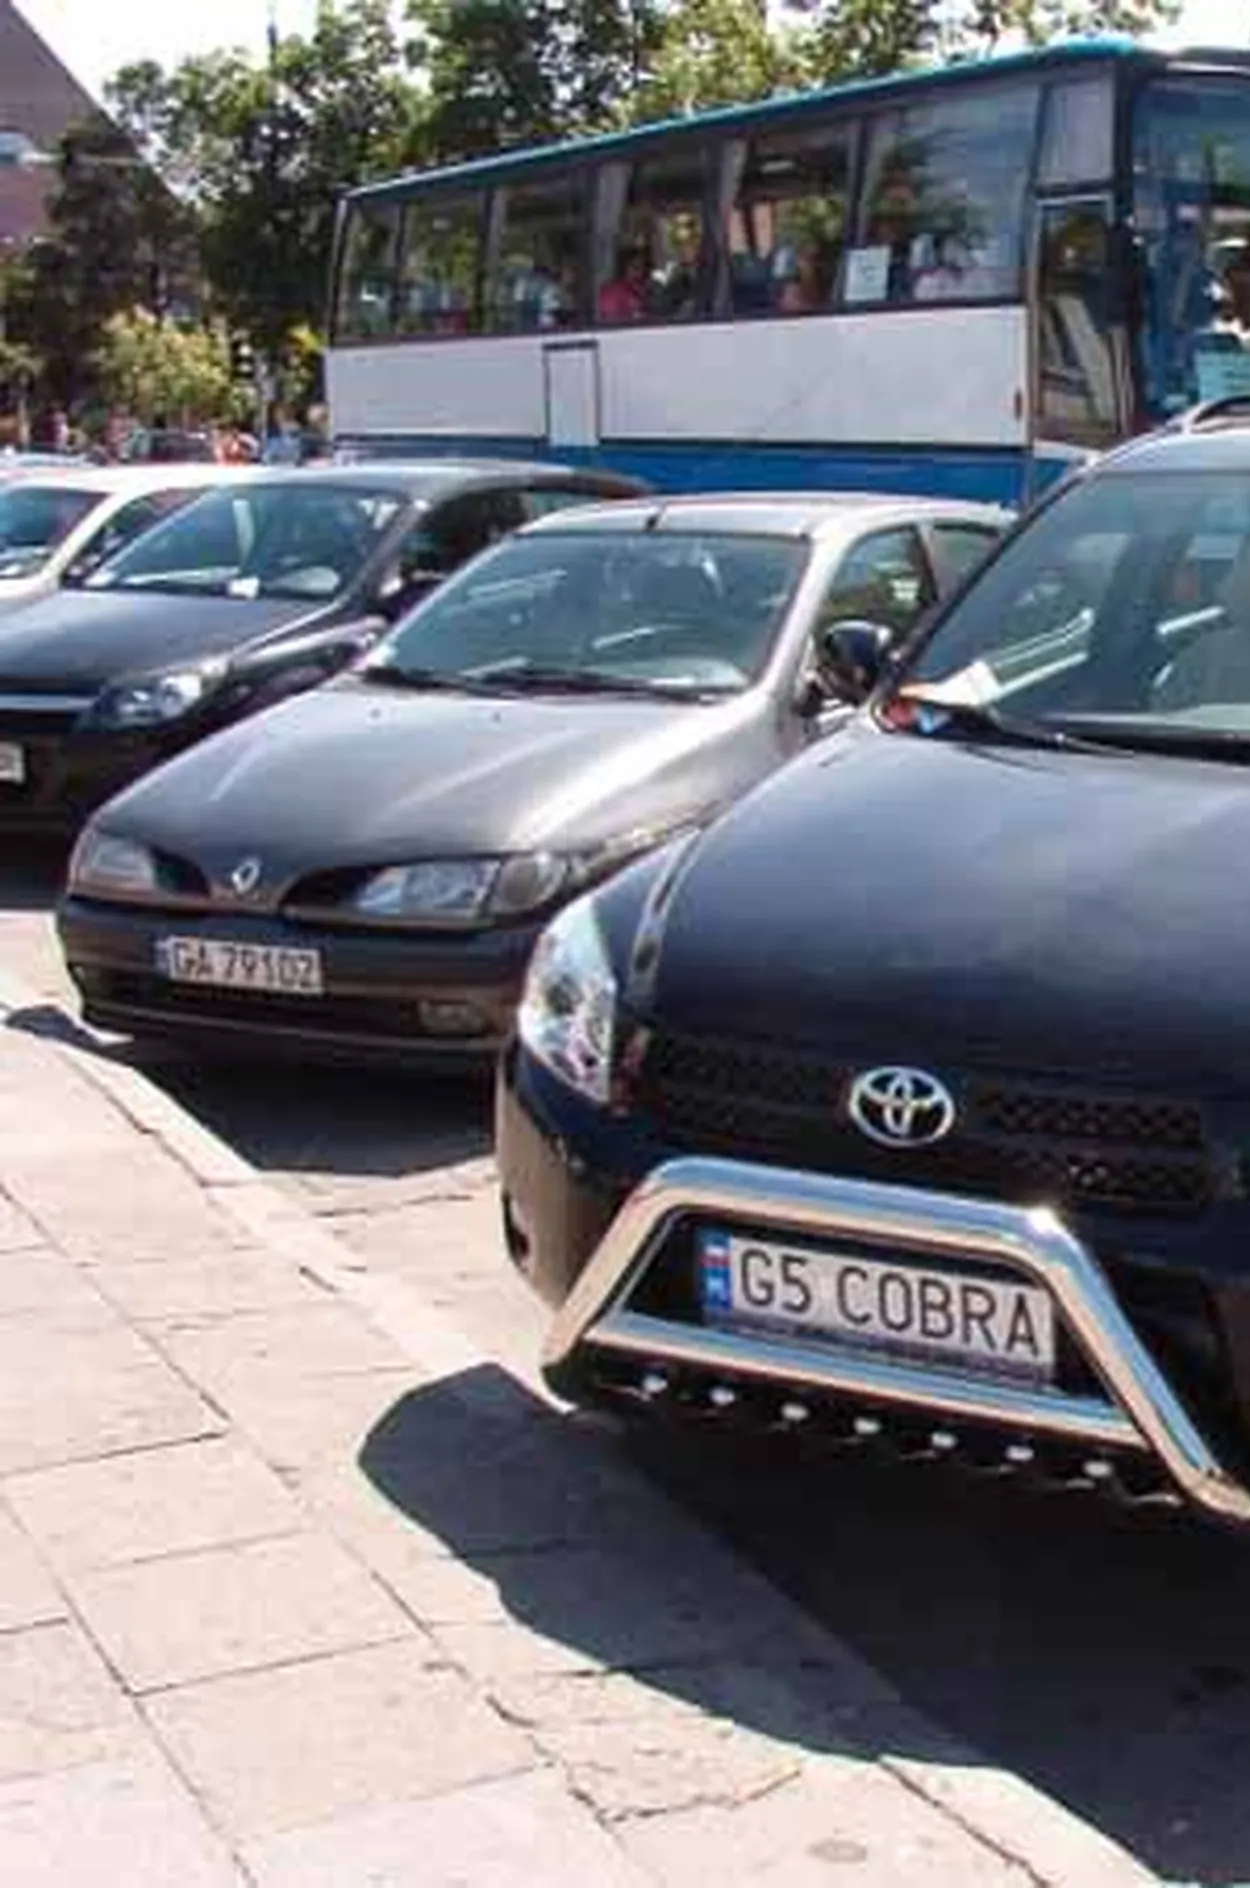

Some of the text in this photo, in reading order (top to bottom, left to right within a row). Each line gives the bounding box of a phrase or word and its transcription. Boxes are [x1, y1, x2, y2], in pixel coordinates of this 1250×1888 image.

[173, 942, 214, 977] GA
[740, 1248, 1039, 1357] G5 COBRA
